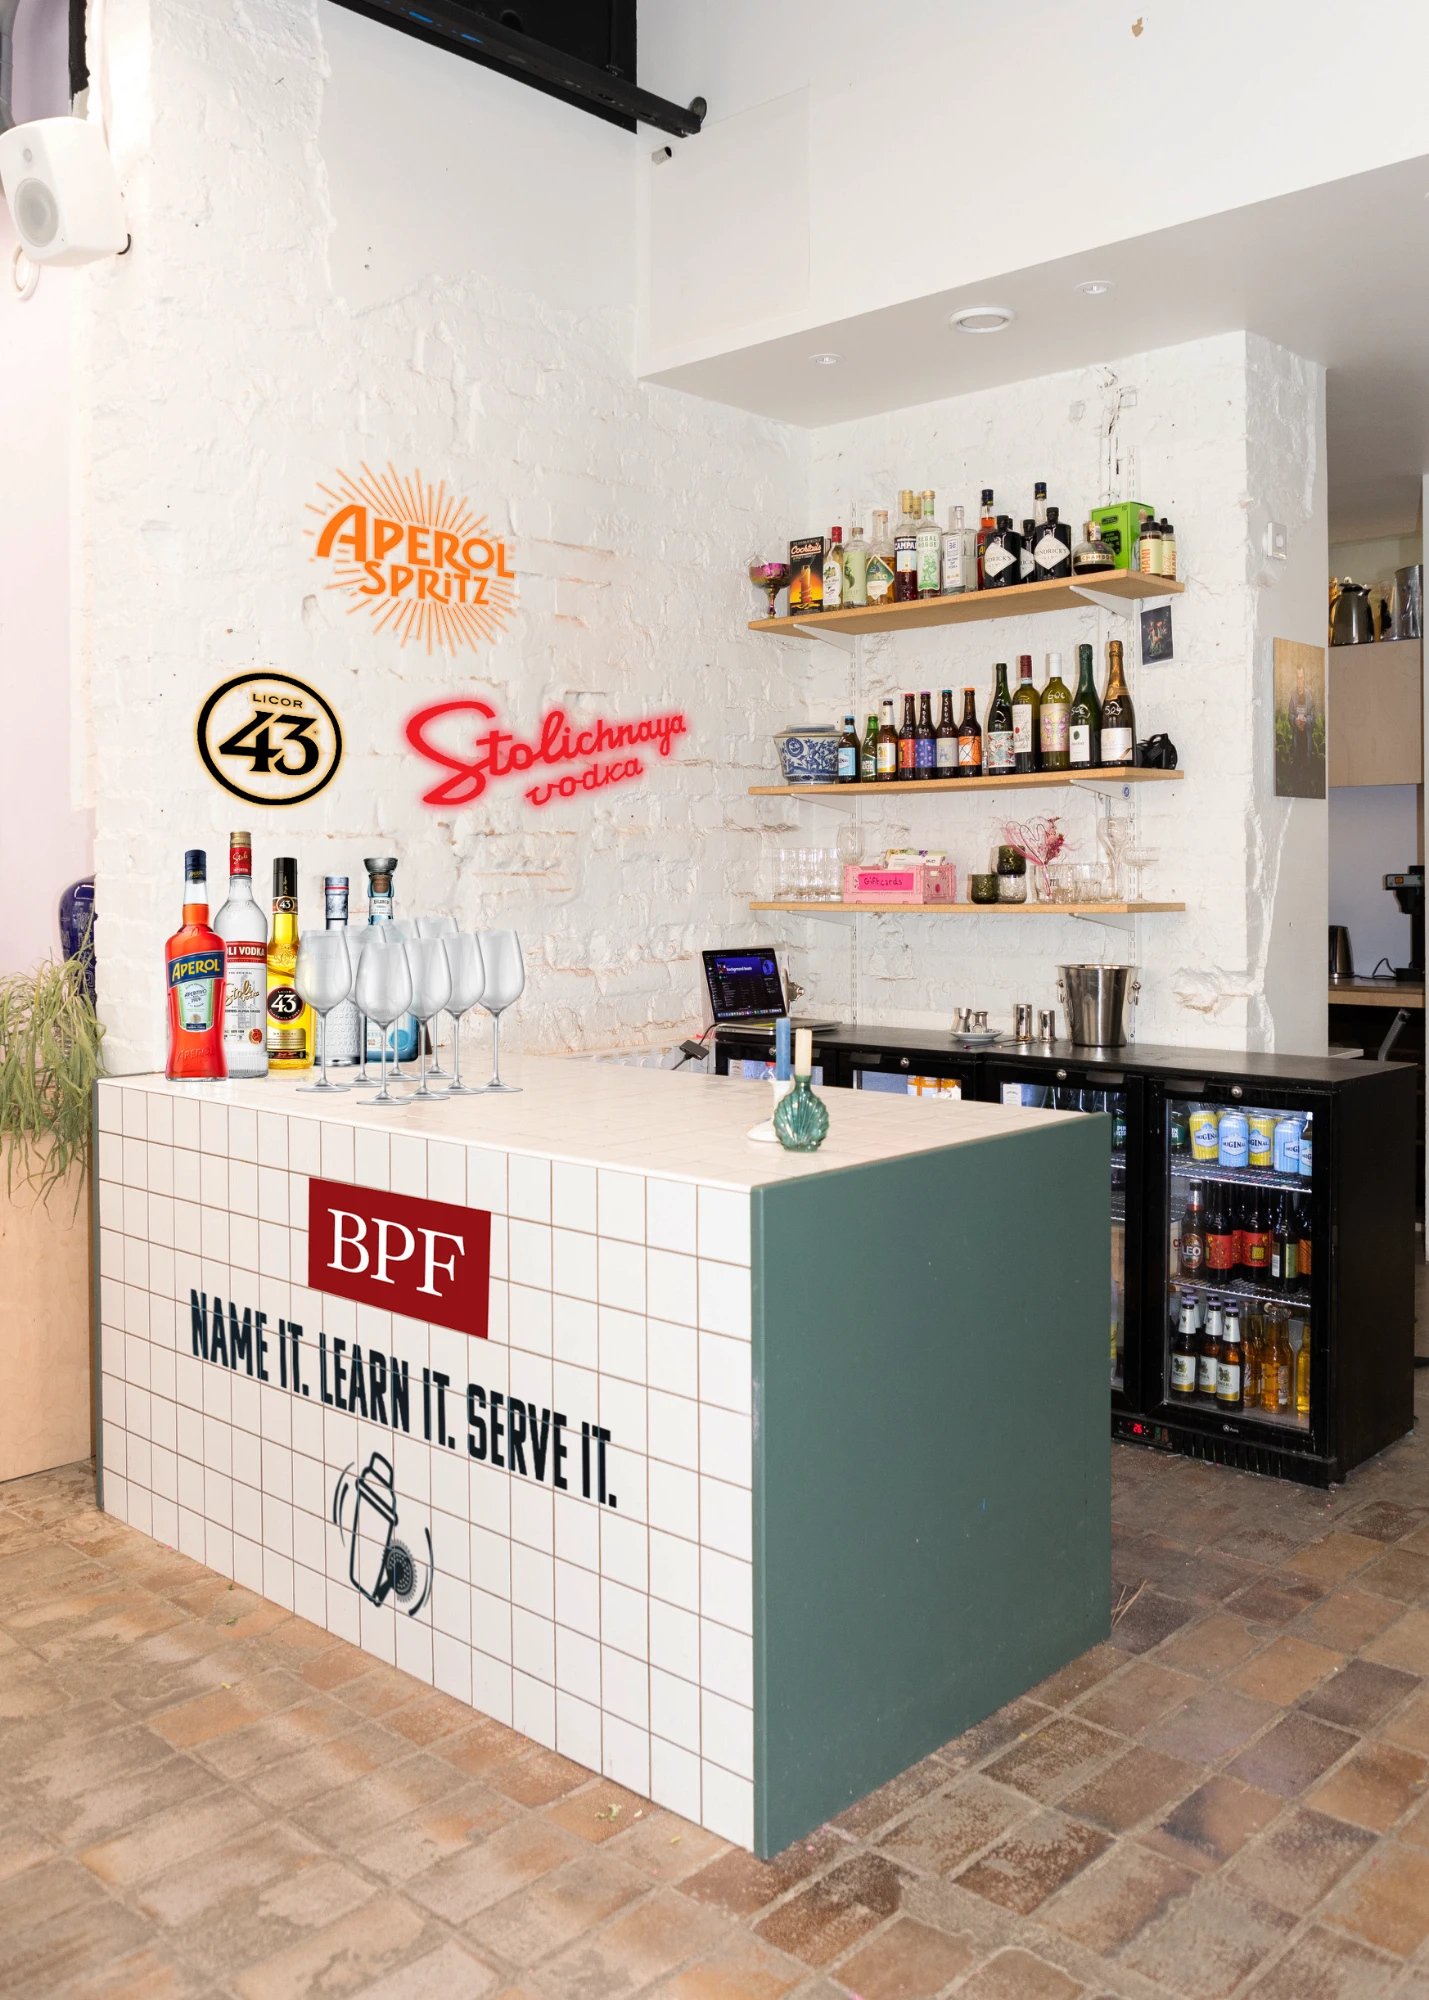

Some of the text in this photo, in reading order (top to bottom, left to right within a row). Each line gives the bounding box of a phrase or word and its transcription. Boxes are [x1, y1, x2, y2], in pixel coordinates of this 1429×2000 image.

[317, 504, 515, 579] APEROL
[895, 541, 916, 551] CAMPA
[252, 693, 304, 709] LICOR
[218, 710, 320, 776] 43
[405, 700, 687, 806] Stolichnaya
[238, 946, 265, 957] VODKA
[171, 958, 221, 983] APEROL
[270, 994, 297, 1013] 43
[326, 1208, 465, 1297] BPF
[1183, 1245, 1201, 1256] LEO
[190, 1288, 617, 1509] NAME IT. LEARN IT. SERVE IT.
